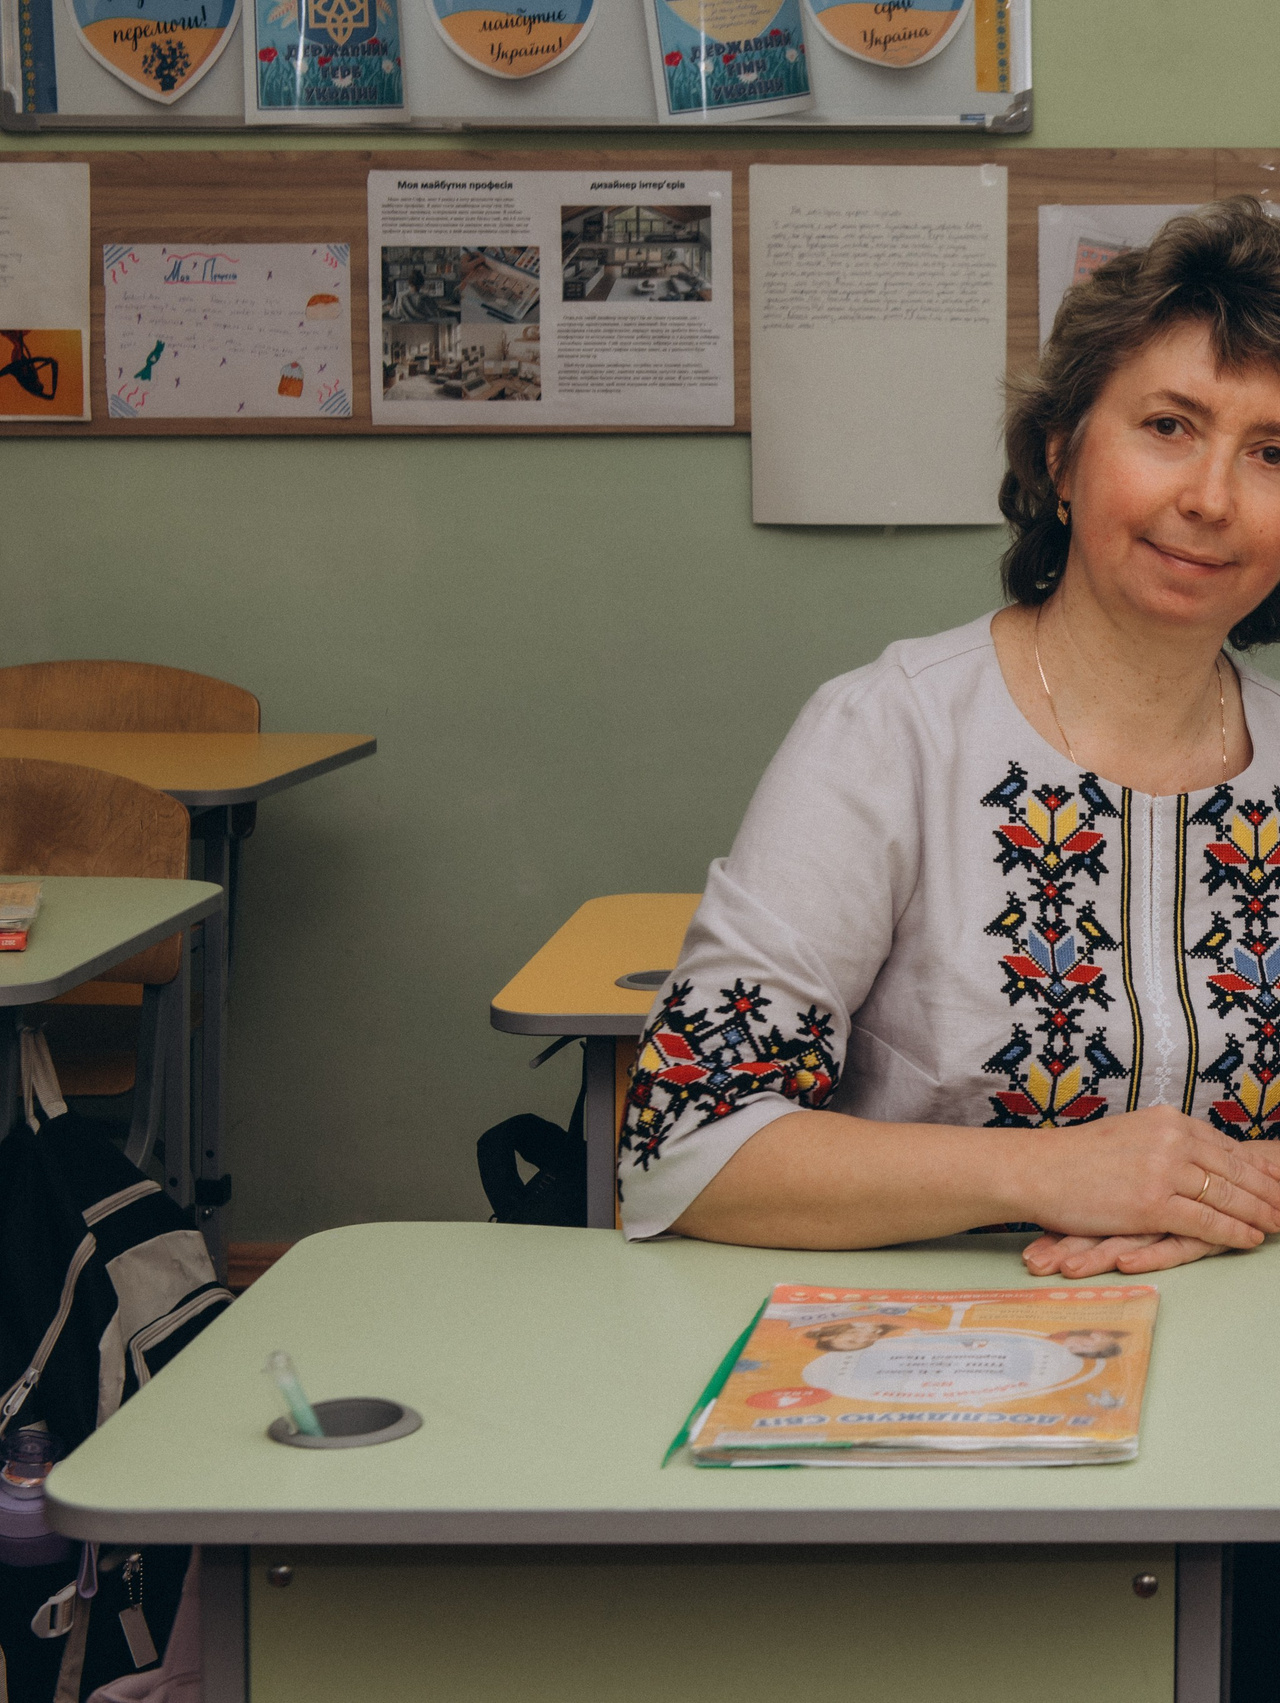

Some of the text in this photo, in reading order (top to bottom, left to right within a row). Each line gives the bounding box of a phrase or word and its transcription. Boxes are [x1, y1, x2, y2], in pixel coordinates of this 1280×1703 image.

[113, 5, 208, 51] перемоги!
[478, 7, 566, 34] майбутнє
[690, 29, 791, 63] ДЕРЖАВНИЙ
[861, 26, 931, 51] Україна
[285, 39, 389, 61] ДЕРЖАВНИЙ
[489, 36, 563, 65] України!
[320, 66, 362, 79] ГЕРБ
[727, 59, 766, 77] ГІМН
[305, 85, 378, 101] УКРАЇНИ
[712, 78, 784, 101] УКРАЇНИ
[397, 179, 513, 192] Моя майбутня професія
[590, 180, 636, 191] дизайнер
[778, 1397, 802, 1408] 4
[751, 1412, 1097, 1428] Я ДОСЛІДЖУЮ СВІТ
